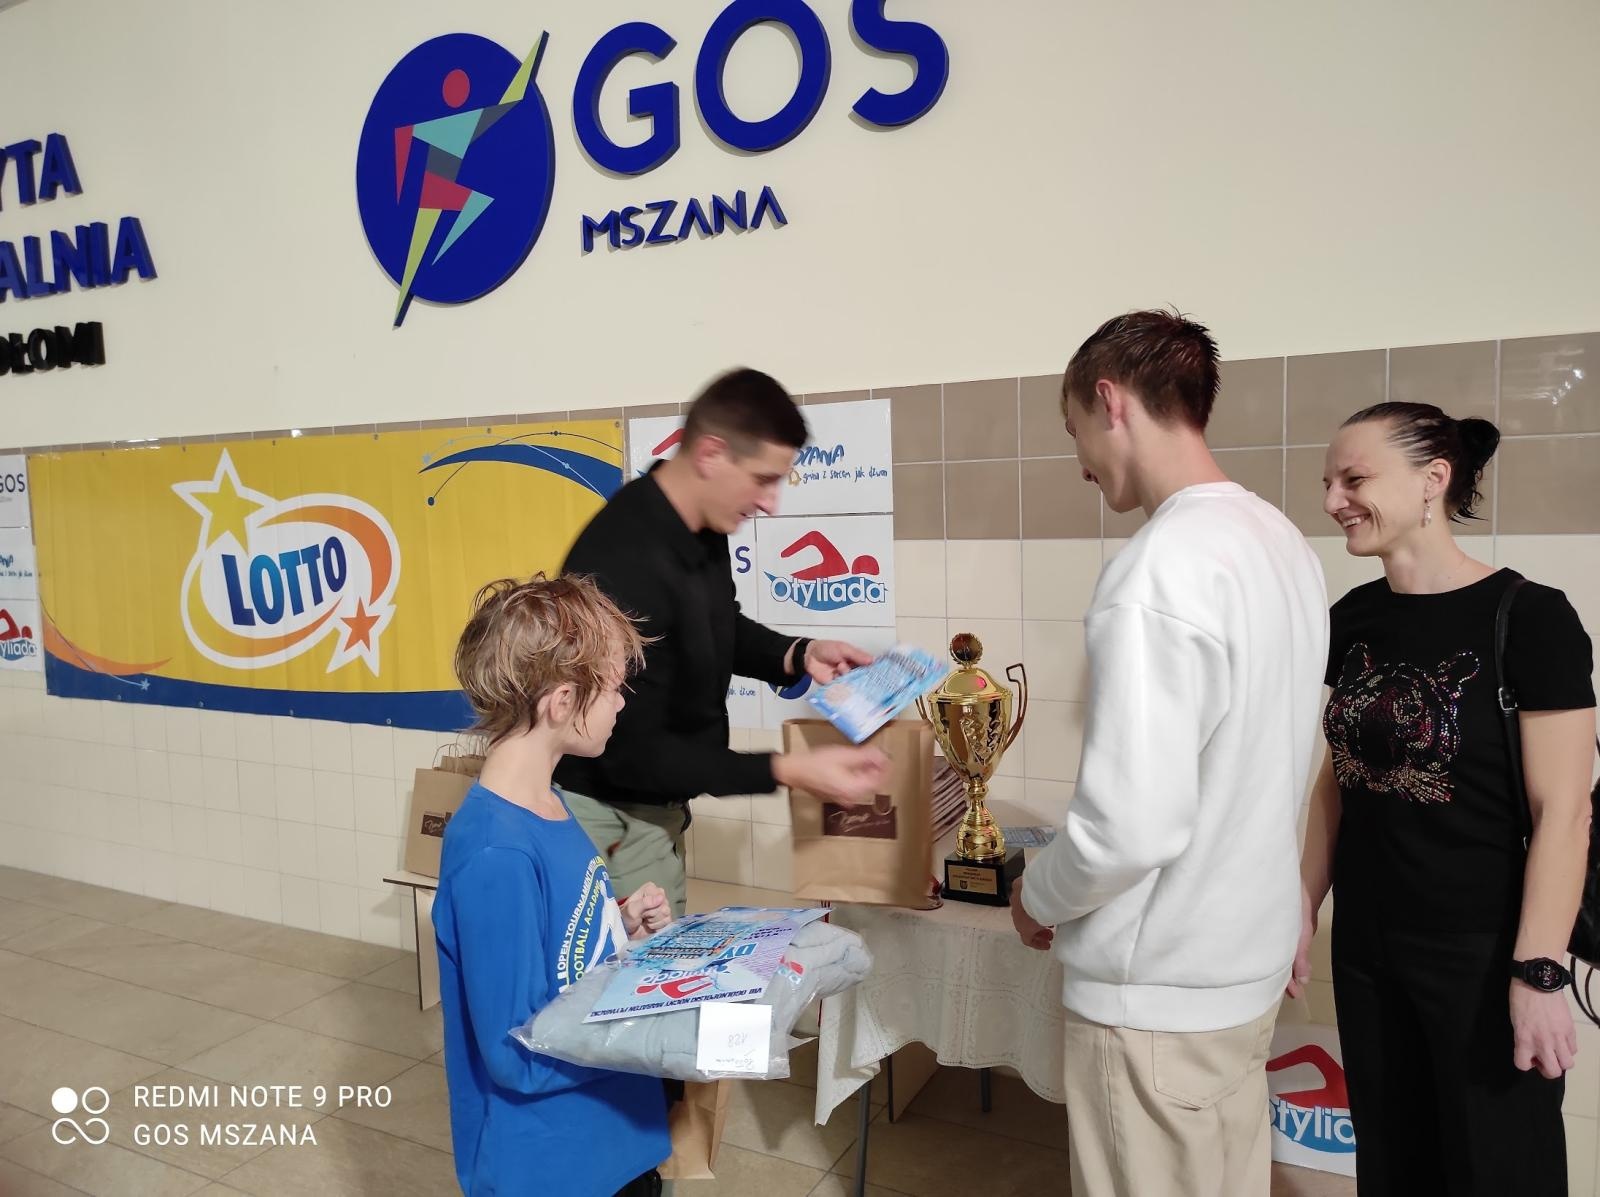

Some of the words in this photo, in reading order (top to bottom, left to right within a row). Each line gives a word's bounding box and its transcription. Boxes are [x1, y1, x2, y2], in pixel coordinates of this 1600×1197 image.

[573, 0, 949, 175] GOS
[0, 133, 83, 212] TA
[582, 185, 788, 253] MSZANA
[221, 536, 347, 626] LOTTO
[770, 576, 886, 608] Otyliada
[557, 941, 569, 971] OPEN
[574, 927, 589, 981] OOTBALL
[1269, 1099, 1356, 1145] tylia
